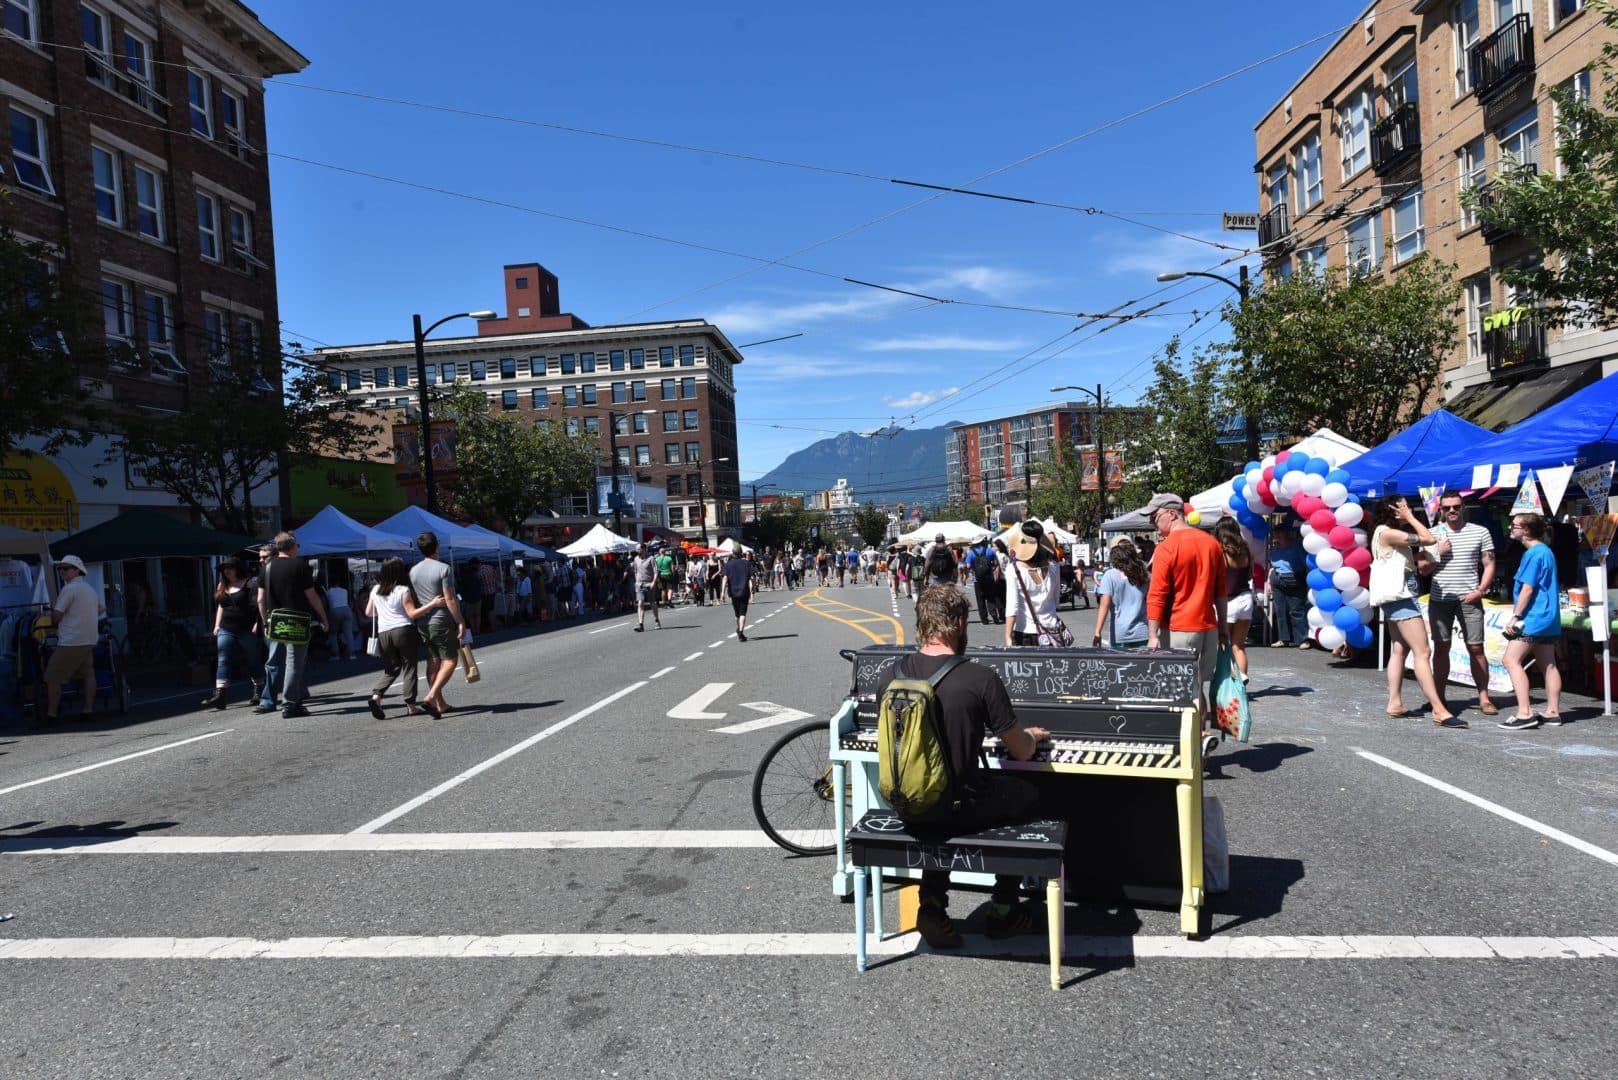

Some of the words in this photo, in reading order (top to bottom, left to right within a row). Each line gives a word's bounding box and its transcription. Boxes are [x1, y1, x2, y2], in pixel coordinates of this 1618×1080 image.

[1226, 215, 1256, 226] POWER
[1004, 661, 1043, 677] MUST
[1034, 676, 1070, 694] LOSE
[1078, 659, 1107, 671] OUR
[1107, 667, 1128, 684] OF
[1160, 664, 1194, 676] WRONG
[906, 844, 985, 871] DREAM
